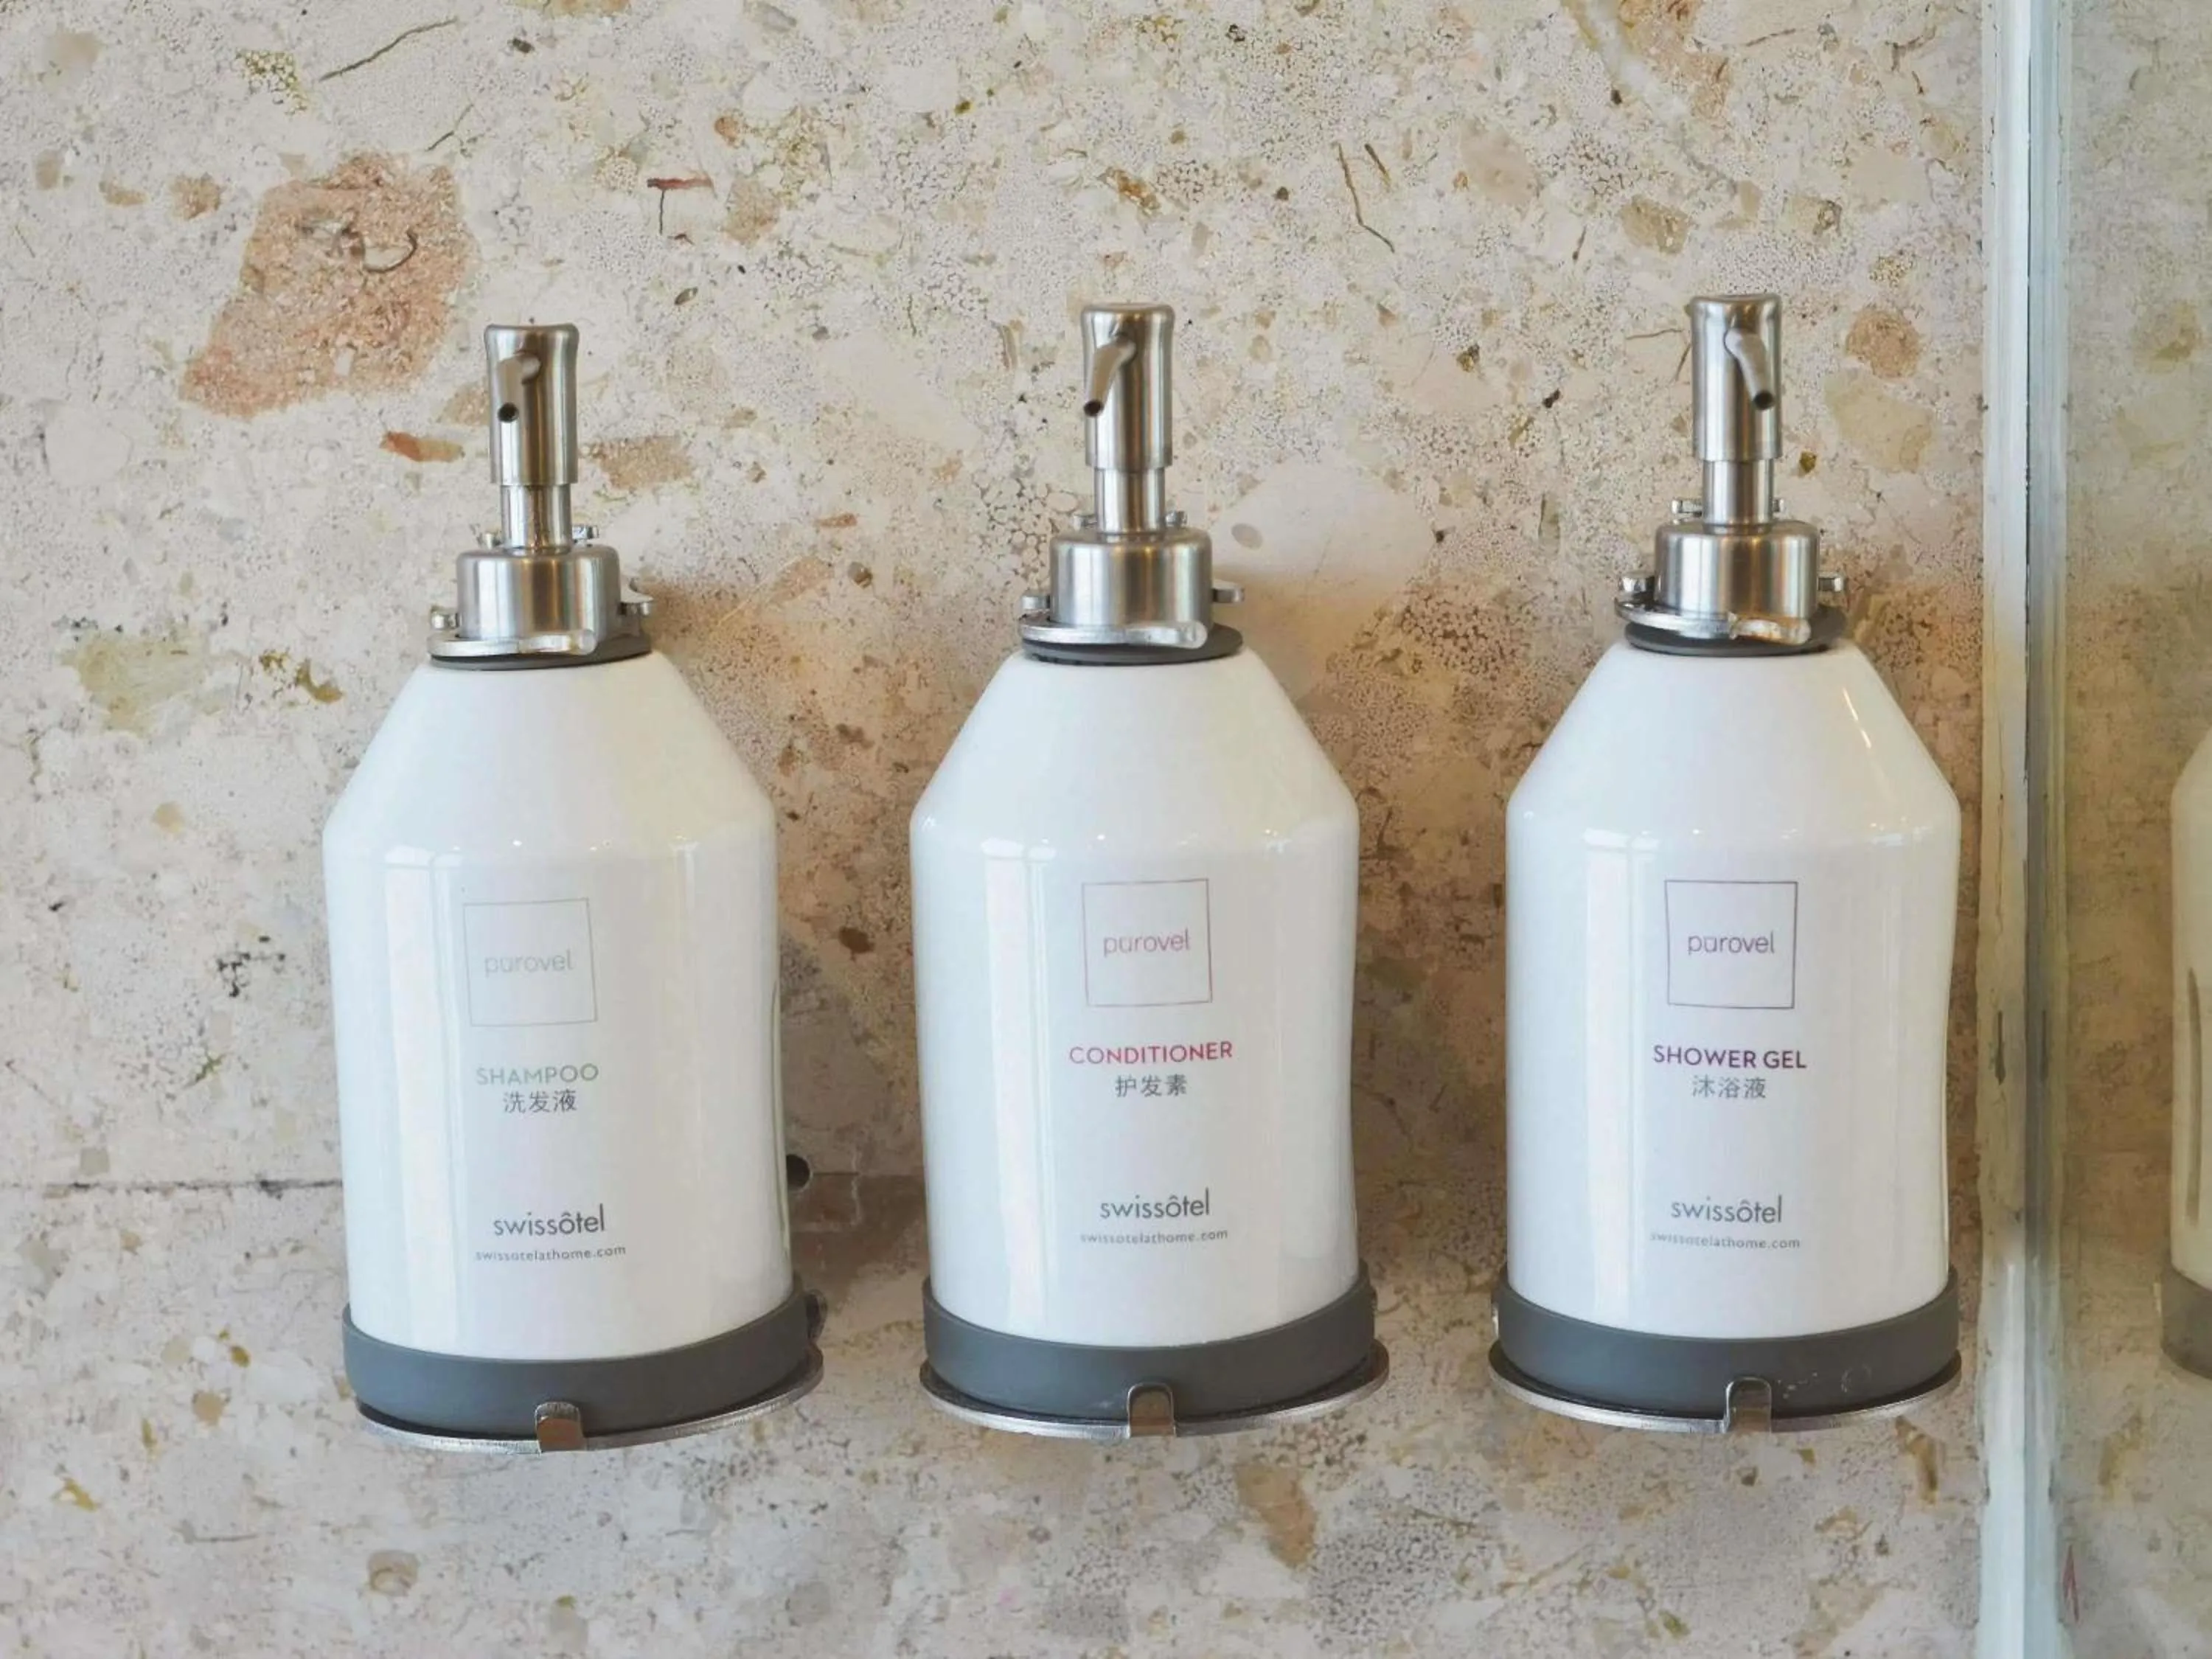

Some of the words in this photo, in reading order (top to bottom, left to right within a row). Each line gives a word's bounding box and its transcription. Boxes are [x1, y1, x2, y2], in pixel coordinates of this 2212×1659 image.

[1103, 927, 1192, 958] purovel
[1687, 930, 1775, 956] purovel
[484, 949, 574, 978] purovel
[1069, 1040, 1234, 1065] CONDITIONER
[1653, 1044, 1756, 1069] SHOWER
[1763, 1050, 1807, 1069] GEL
[476, 1062, 599, 1085] SHAMPOO
[1115, 1074, 1188, 1098] 护发素
[1691, 1074, 1767, 1099] 沐浴液
[503, 1088, 578, 1113] 洗发液
[1100, 1186, 1211, 1219] swissôtel
[1670, 1194, 1783, 1224] swissôtel
[493, 1203, 605, 1237] swissôtel
